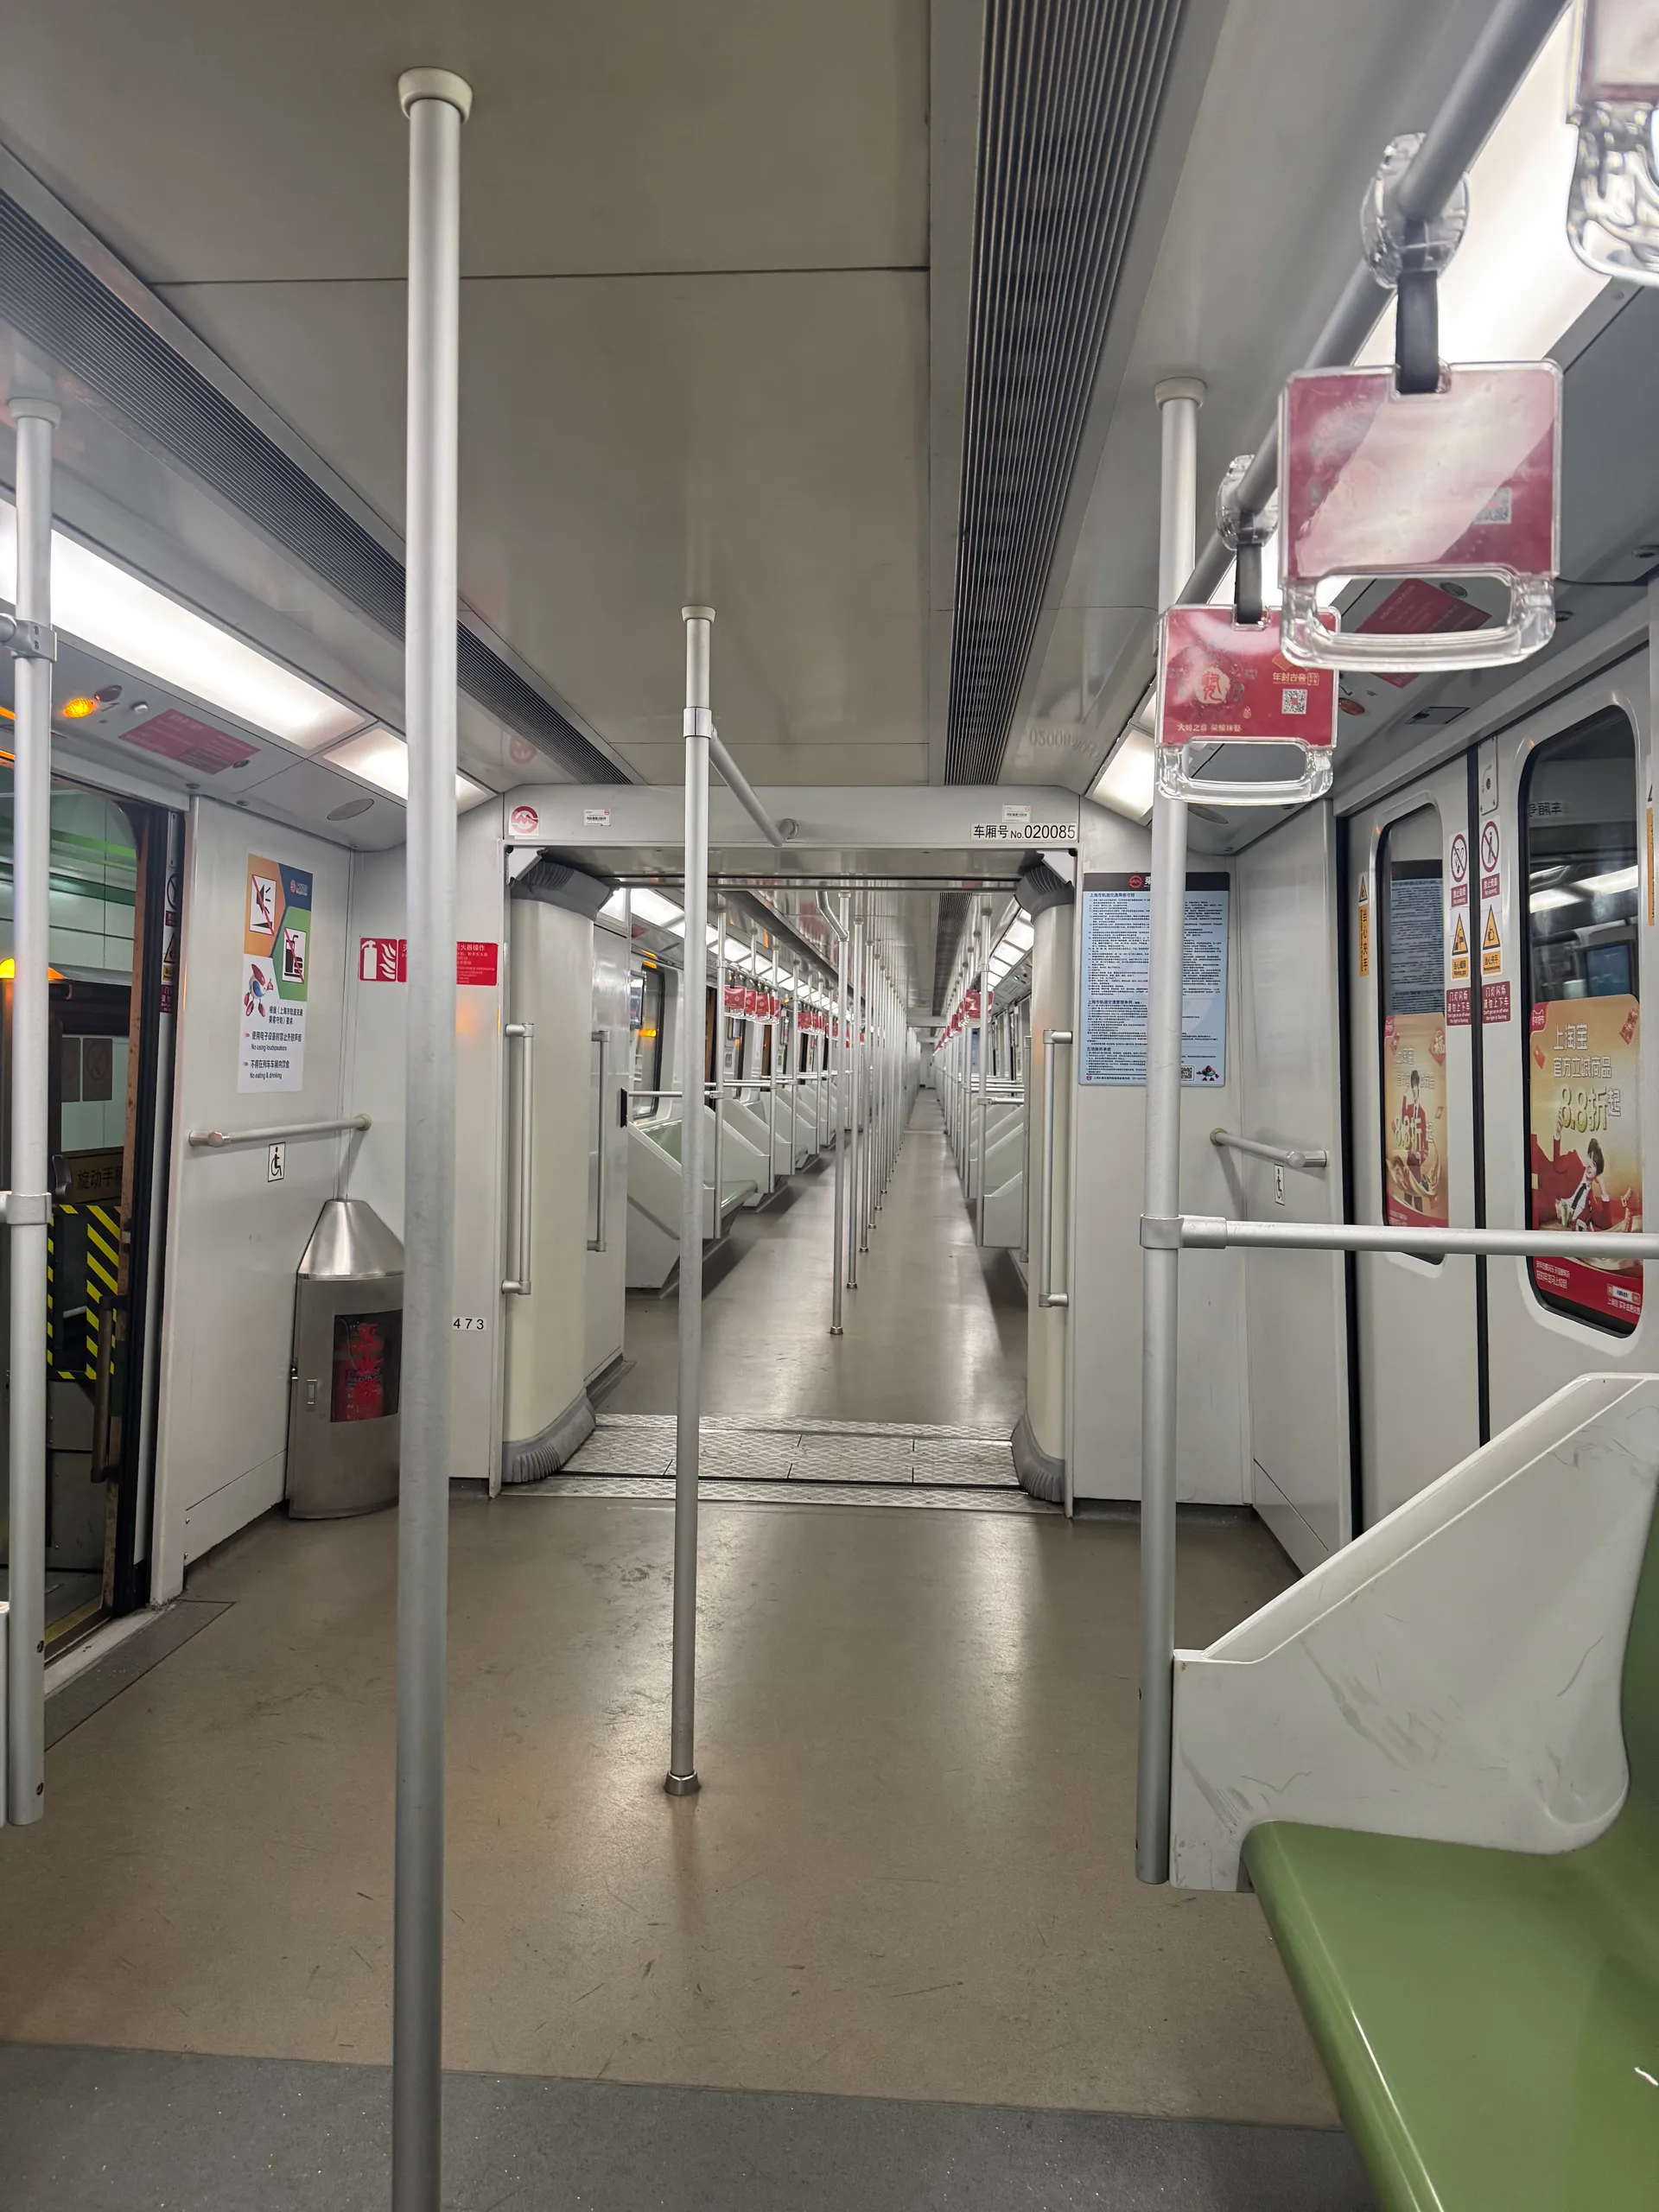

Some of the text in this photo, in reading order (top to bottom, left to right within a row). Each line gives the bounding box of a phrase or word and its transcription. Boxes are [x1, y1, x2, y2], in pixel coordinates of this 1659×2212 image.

[974, 824, 1008, 839] 车厢号
[1450, 990, 1467, 1001] 门灯闪烁
[1486, 985, 1506, 997] 门灯闪烁
[1484, 997, 1508, 1009] 请勿上下车
[1554, 1023, 1588, 1051] 上淘宝
[1554, 1056, 1612, 1079] 官方立减商品
